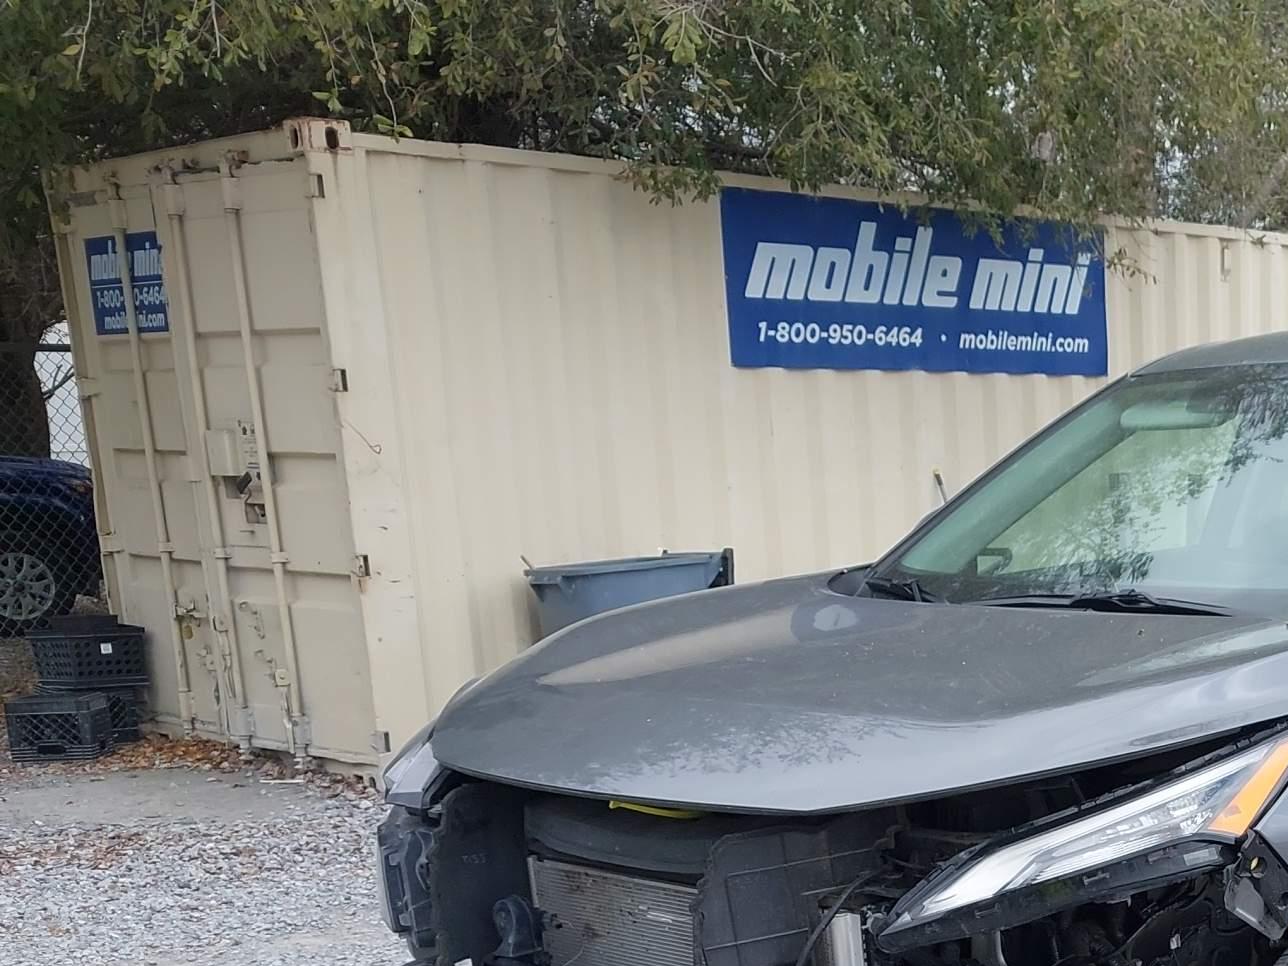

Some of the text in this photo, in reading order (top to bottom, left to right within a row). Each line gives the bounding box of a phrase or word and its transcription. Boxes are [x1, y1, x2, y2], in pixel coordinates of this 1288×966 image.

[745, 221, 1090, 315] mobile mini
[97, 286, 167, 308] 1-800-0-6464
[104, 310, 165, 330] mobilini.com
[758, 321, 1089, 353] 1-800-950-6464 mobilemini.com
